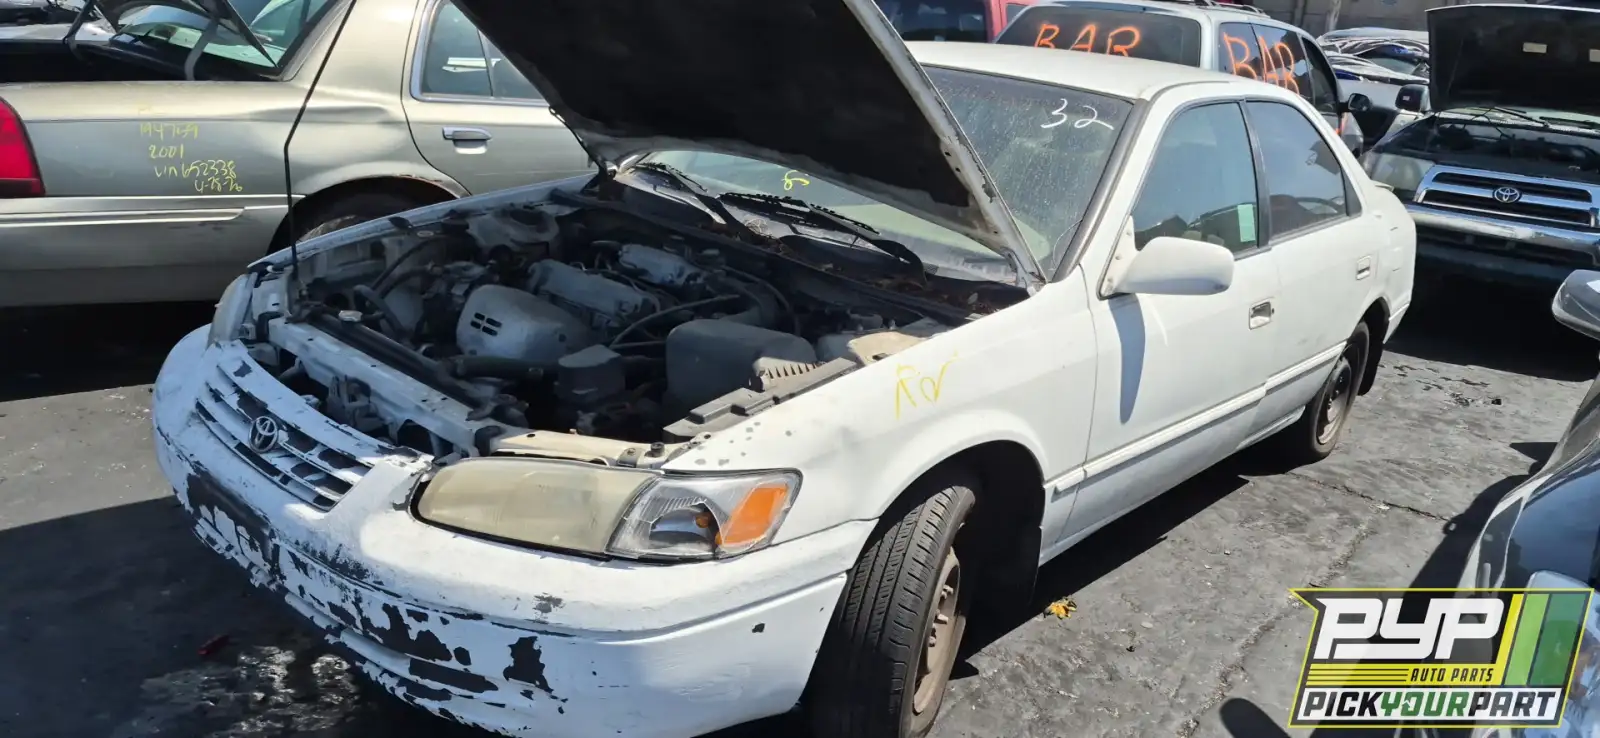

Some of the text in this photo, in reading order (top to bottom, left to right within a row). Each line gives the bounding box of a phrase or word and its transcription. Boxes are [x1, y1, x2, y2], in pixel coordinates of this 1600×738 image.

[1034, 23, 1141, 57] BAR
[1223, 32, 1300, 96] BAR
[1040, 98, 1115, 130] 32
[149, 144, 184, 159] 2001
